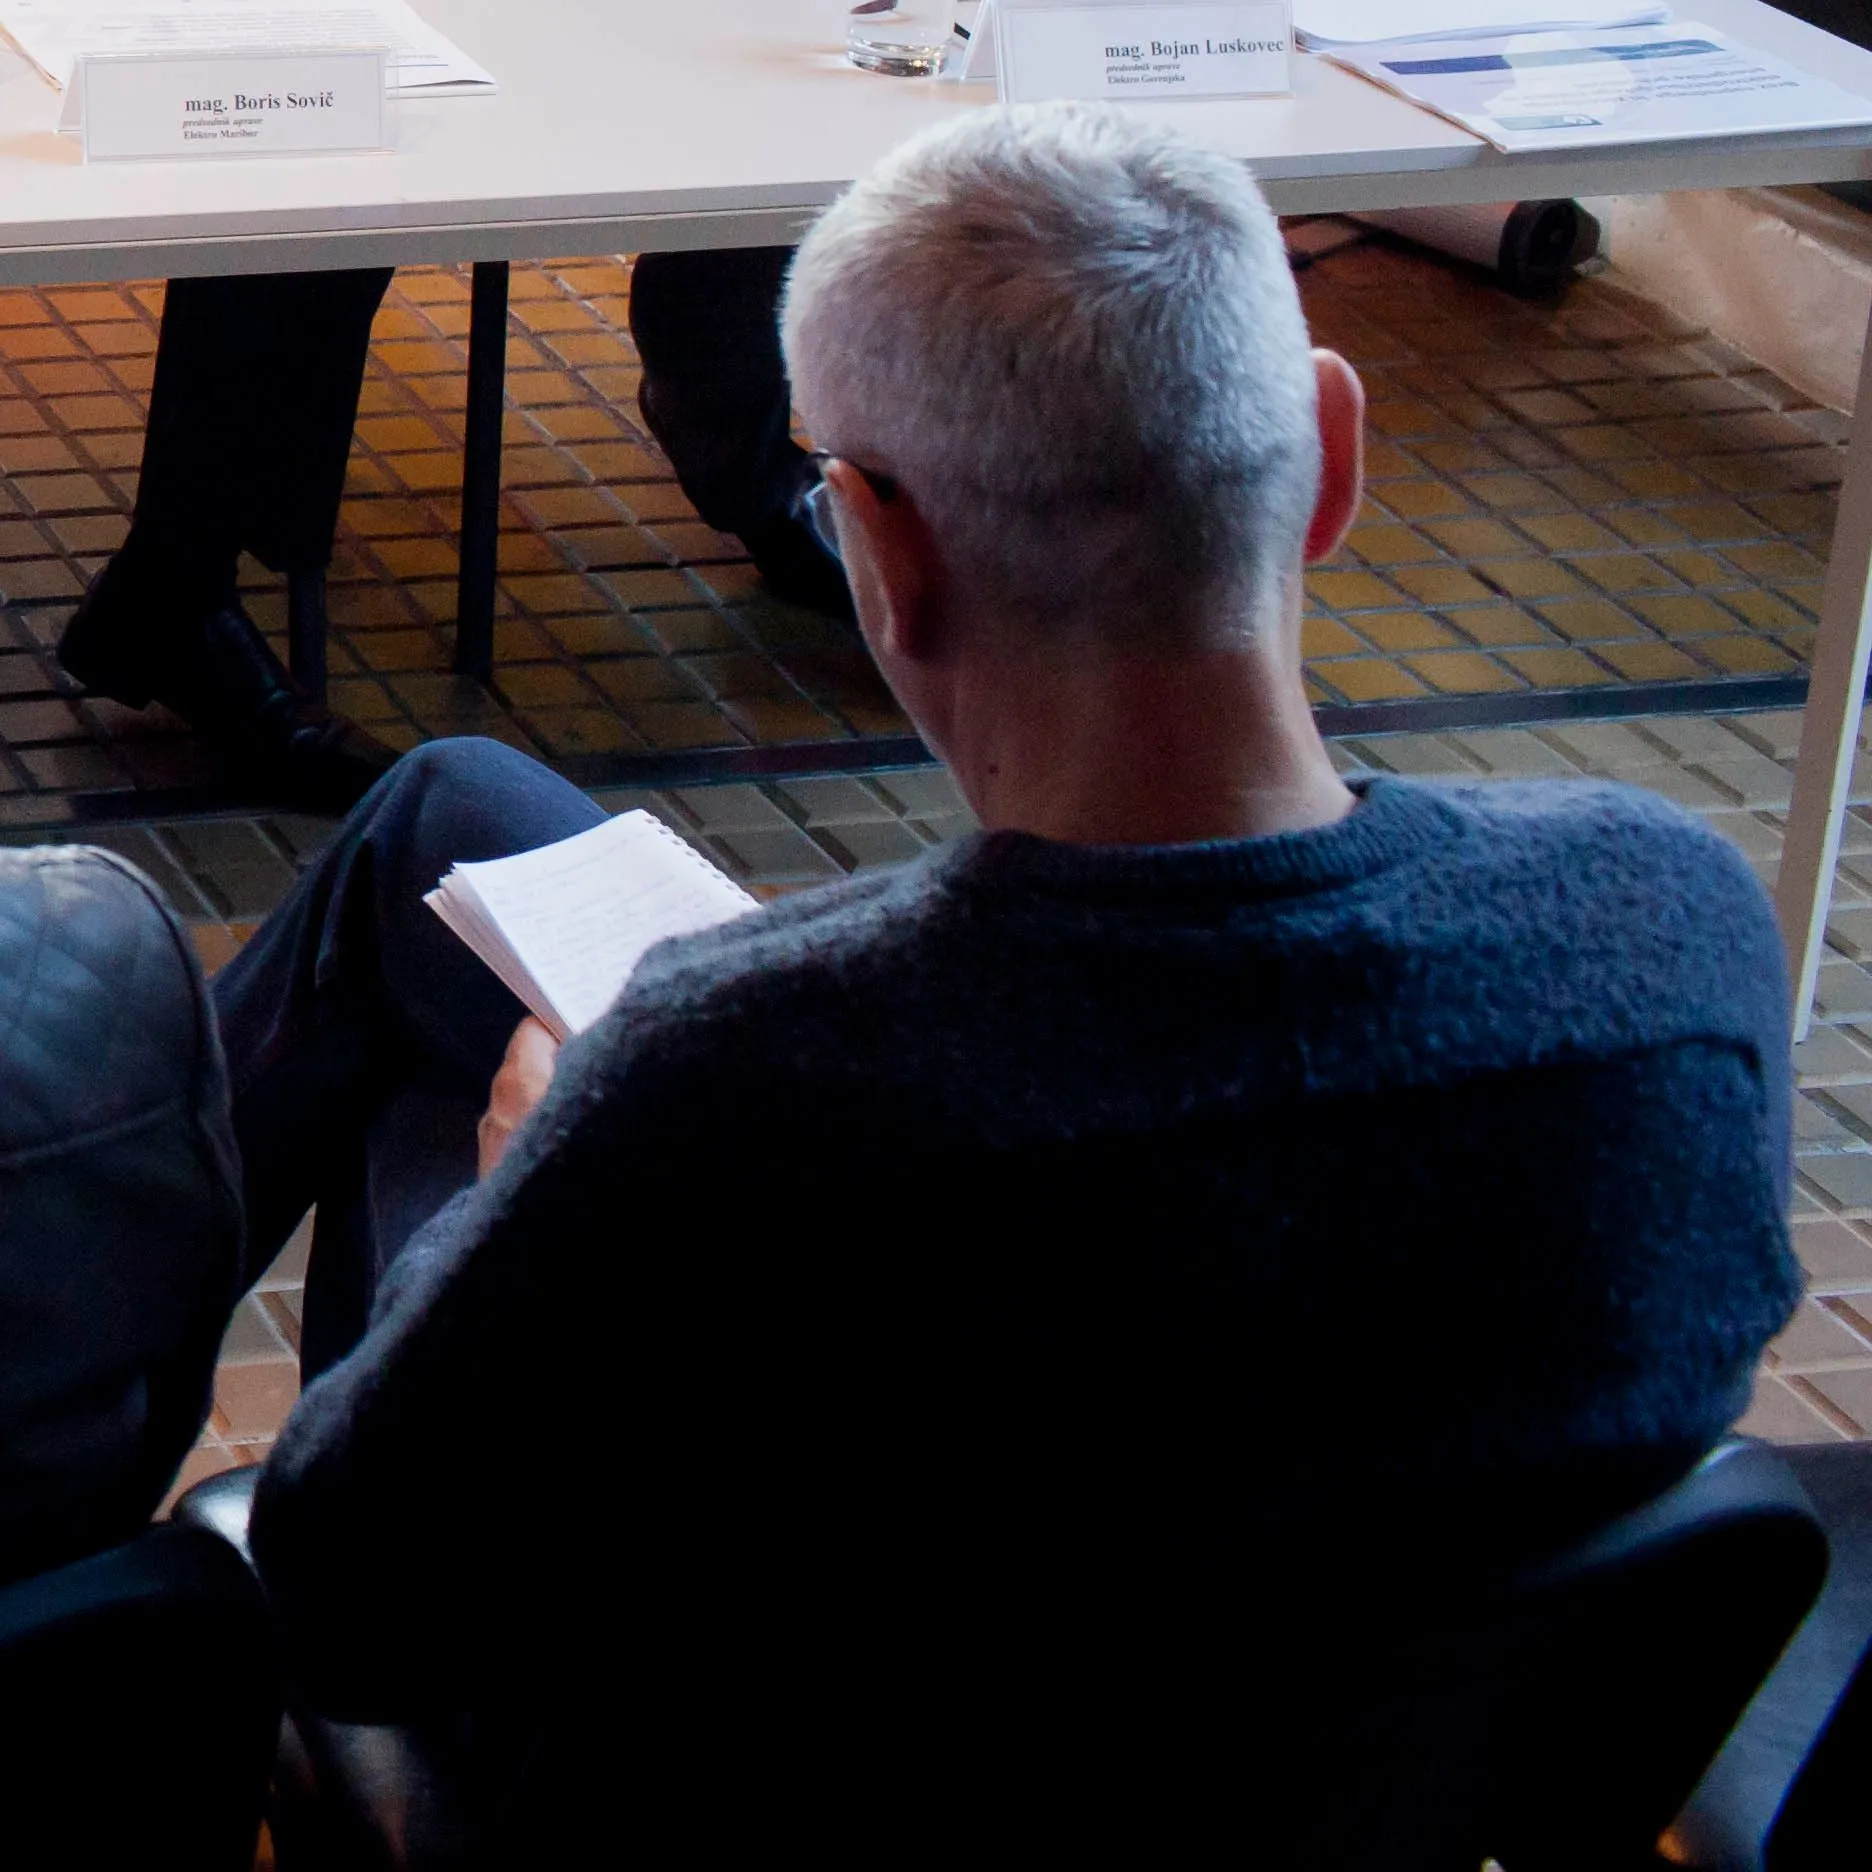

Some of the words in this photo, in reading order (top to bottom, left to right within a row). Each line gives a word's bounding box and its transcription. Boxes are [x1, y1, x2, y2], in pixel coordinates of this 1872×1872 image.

[1105, 44, 1145, 60] mag.
[1151, 39, 1199, 60] Bojan
[1206, 37, 1284, 55] Luskovec
[185, 97, 228, 114] mag.
[234, 93, 281, 111] Boris
[286, 90, 334, 109] Sovič
